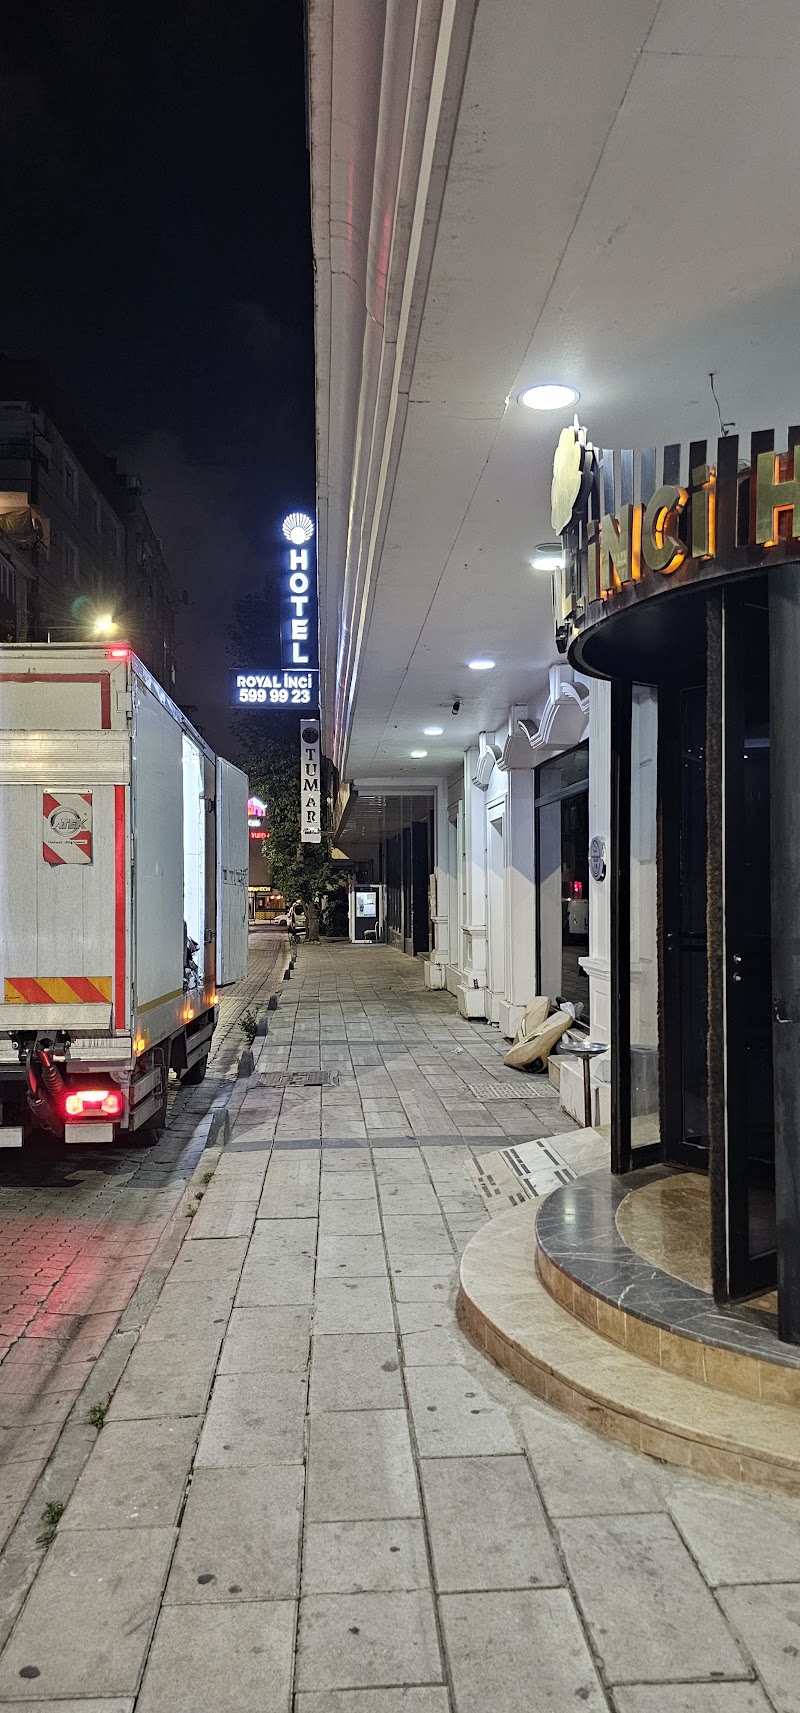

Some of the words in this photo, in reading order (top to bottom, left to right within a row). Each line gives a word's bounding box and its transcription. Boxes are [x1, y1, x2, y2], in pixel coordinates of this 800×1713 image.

[289, 549, 309, 664] HOTEL
[236, 675, 282, 689] ROYAL
[283, 672, 312, 689] İNCİ
[239, 688, 267, 703] 599
[269, 688, 289, 703] 99
[291, 688, 311, 703] 23
[303, 748, 320, 824] TUMAR
[51, 818, 88, 830] ATEK
